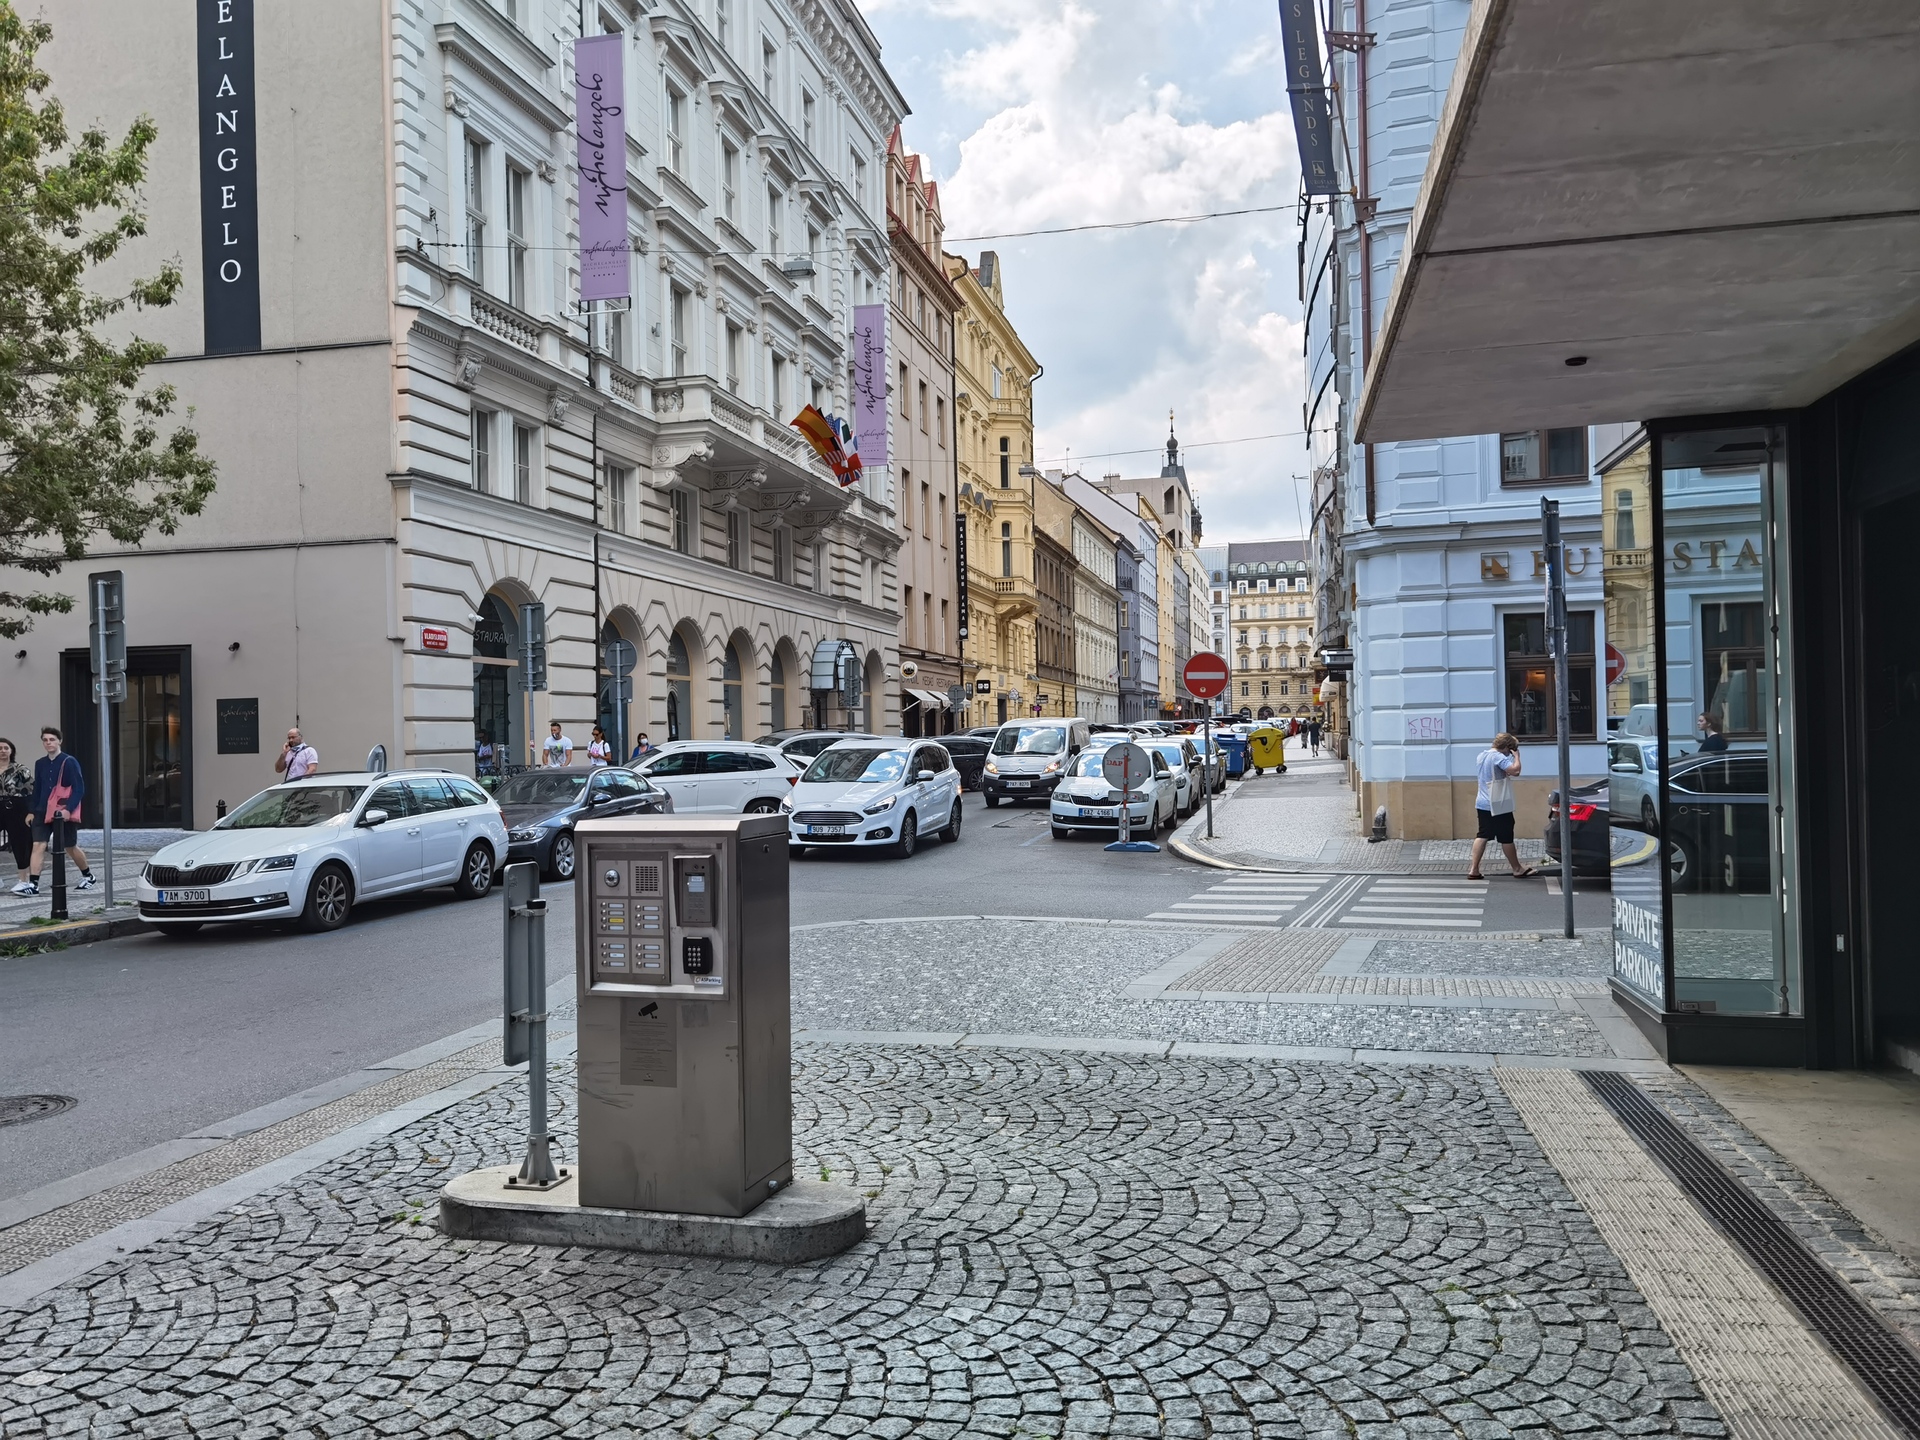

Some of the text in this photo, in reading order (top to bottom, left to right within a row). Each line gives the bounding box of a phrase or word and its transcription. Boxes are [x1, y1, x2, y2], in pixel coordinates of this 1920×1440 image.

[1293, 3, 1301, 18] S
[1296, 30, 1318, 147] LEGENDS
[217, 0, 242, 282] ELANGELO
[164, 890, 205, 901] 7AM 9700
[1615, 897, 1659, 949] PRIVATE
[1615, 940, 1663, 1000] PARKING
